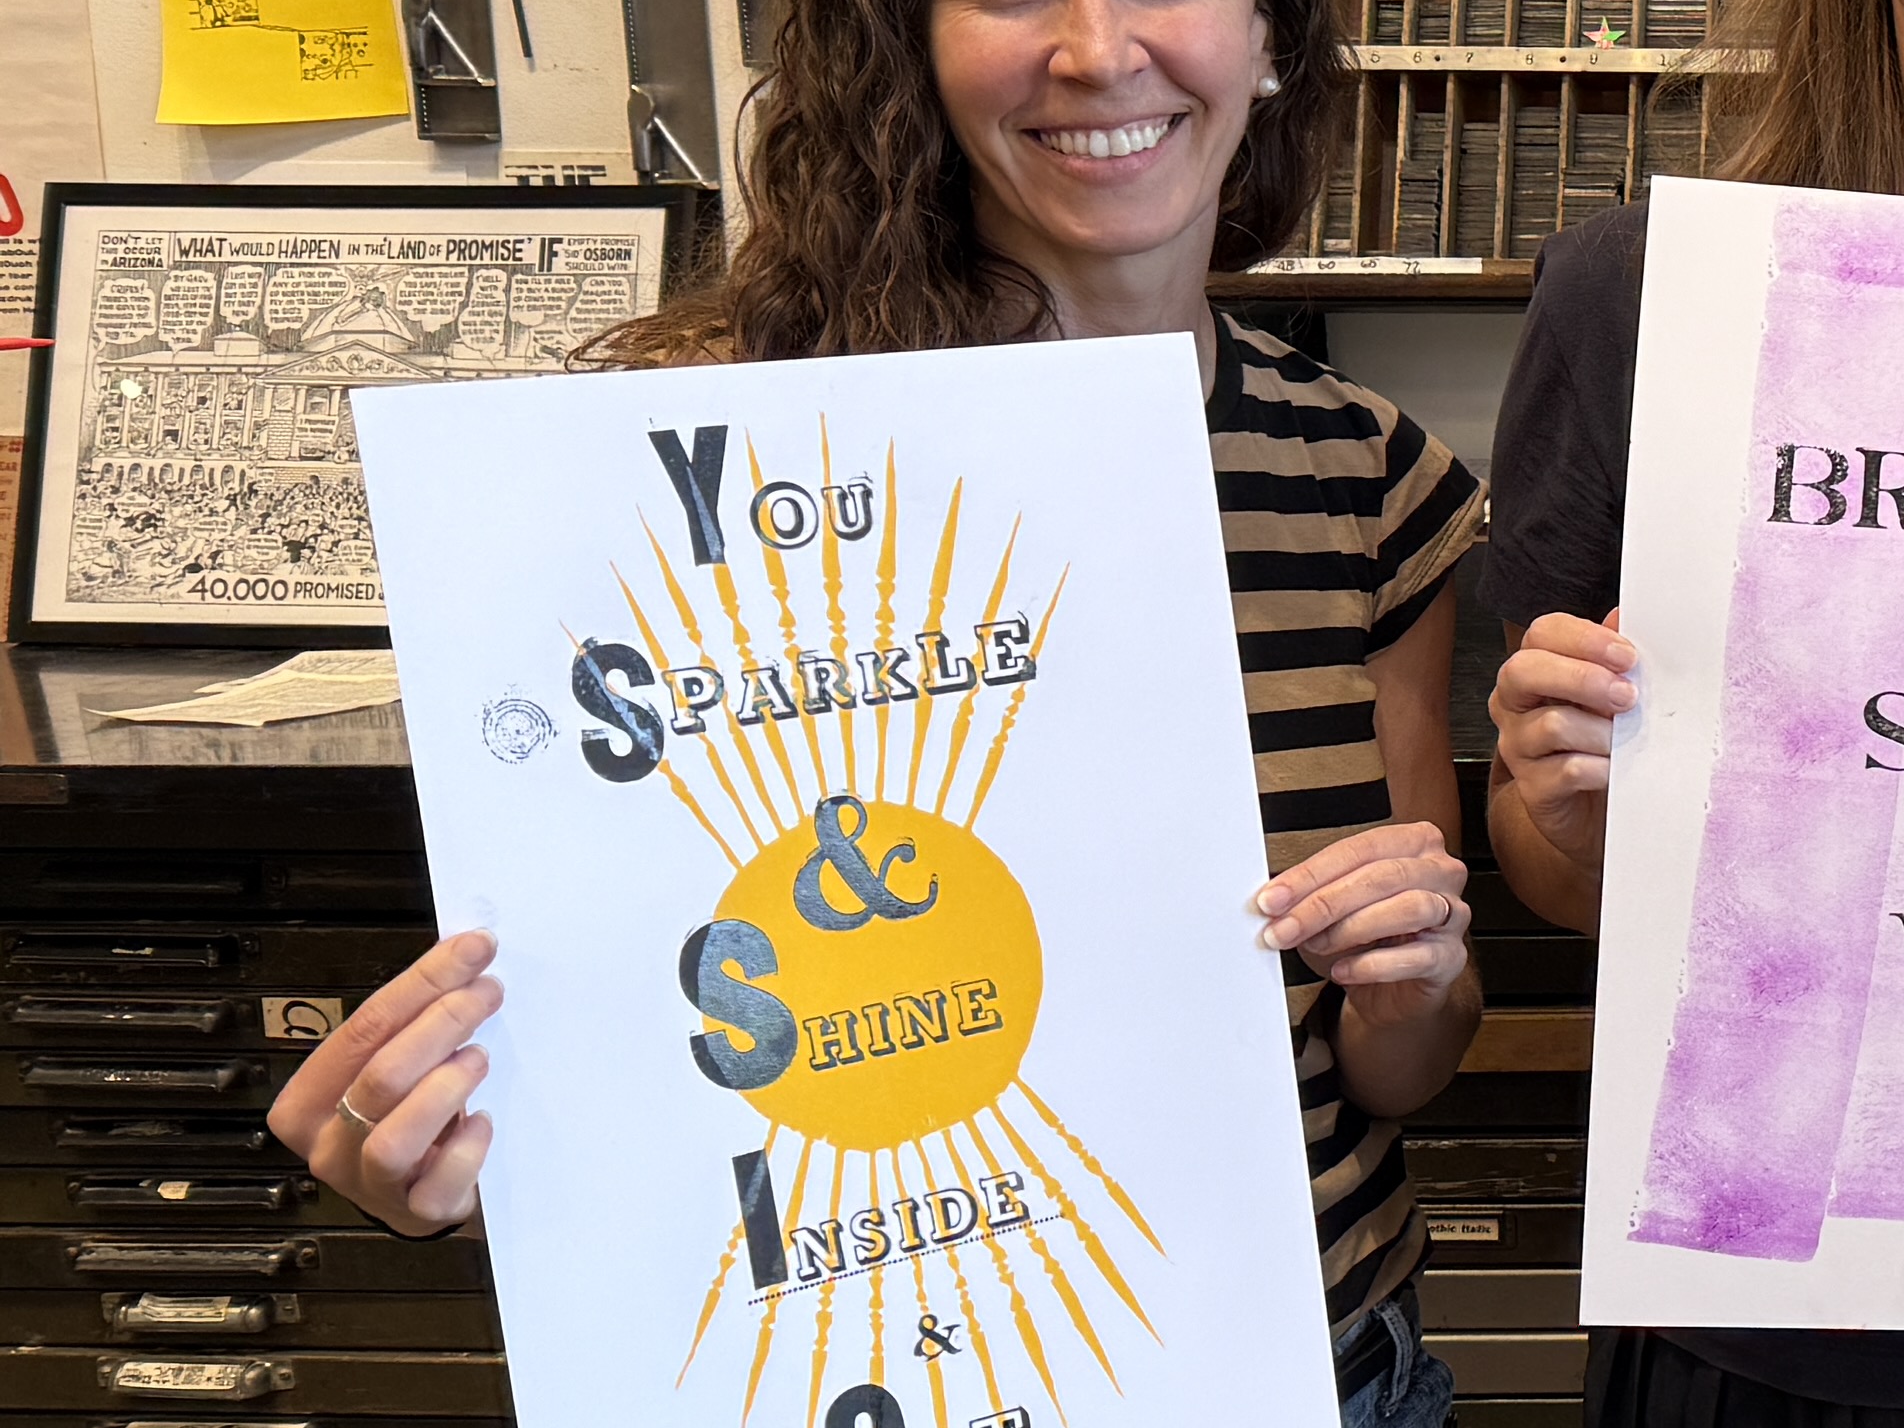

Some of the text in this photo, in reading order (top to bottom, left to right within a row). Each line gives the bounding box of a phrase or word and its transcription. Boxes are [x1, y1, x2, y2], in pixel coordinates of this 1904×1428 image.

[177, 236, 340, 261] WHAT WOULD HAPPEN
[111, 256, 164, 269] ARIZONA
[294, 582, 375, 599] PROMISED
[794, 793, 939, 932] &
[914, 1313, 961, 1362] &
